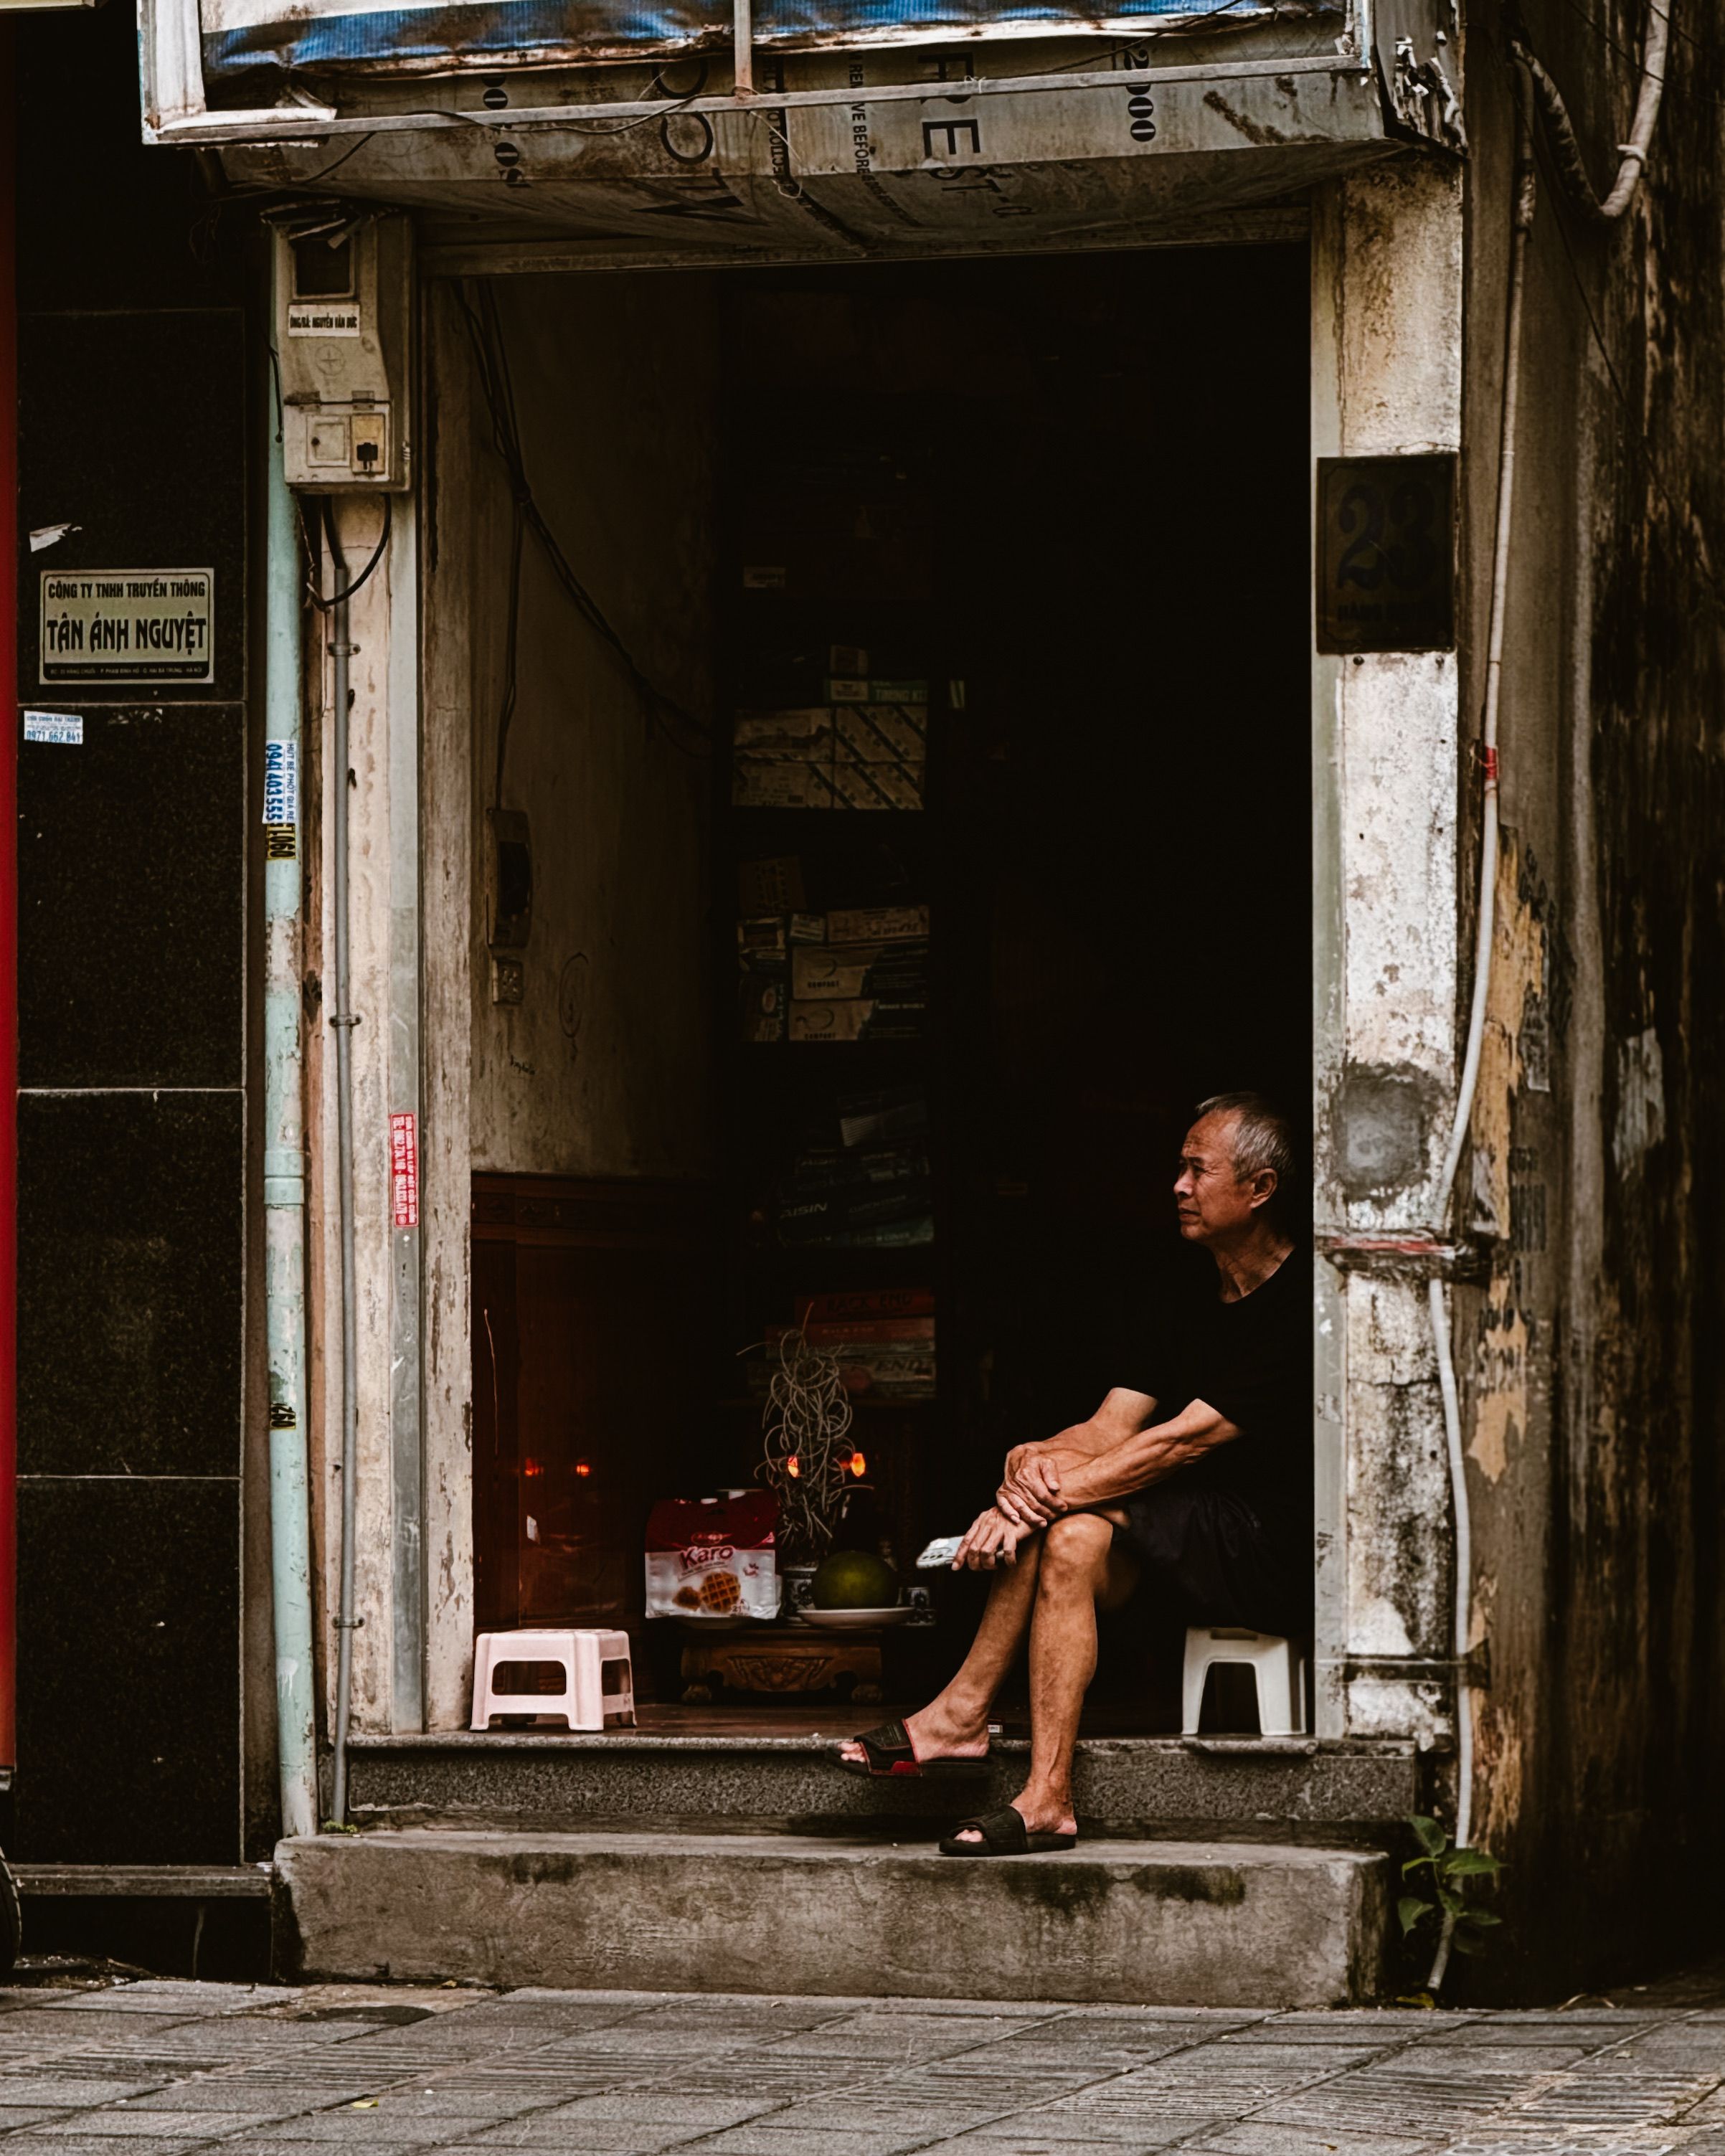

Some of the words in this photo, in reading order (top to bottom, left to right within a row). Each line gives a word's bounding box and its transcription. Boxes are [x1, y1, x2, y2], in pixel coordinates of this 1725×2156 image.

[48, 581, 77, 599] CÔNG
[80, 582, 93, 598] TY
[96, 582, 123, 598] TNHH
[171, 579, 205, 597] THÔNG
[47, 612, 83, 653] TÂN
[90, 612, 129, 653] ÁNH
[136, 611, 207, 656] NGUYỆT
[680, 1546, 734, 1570] Karo
